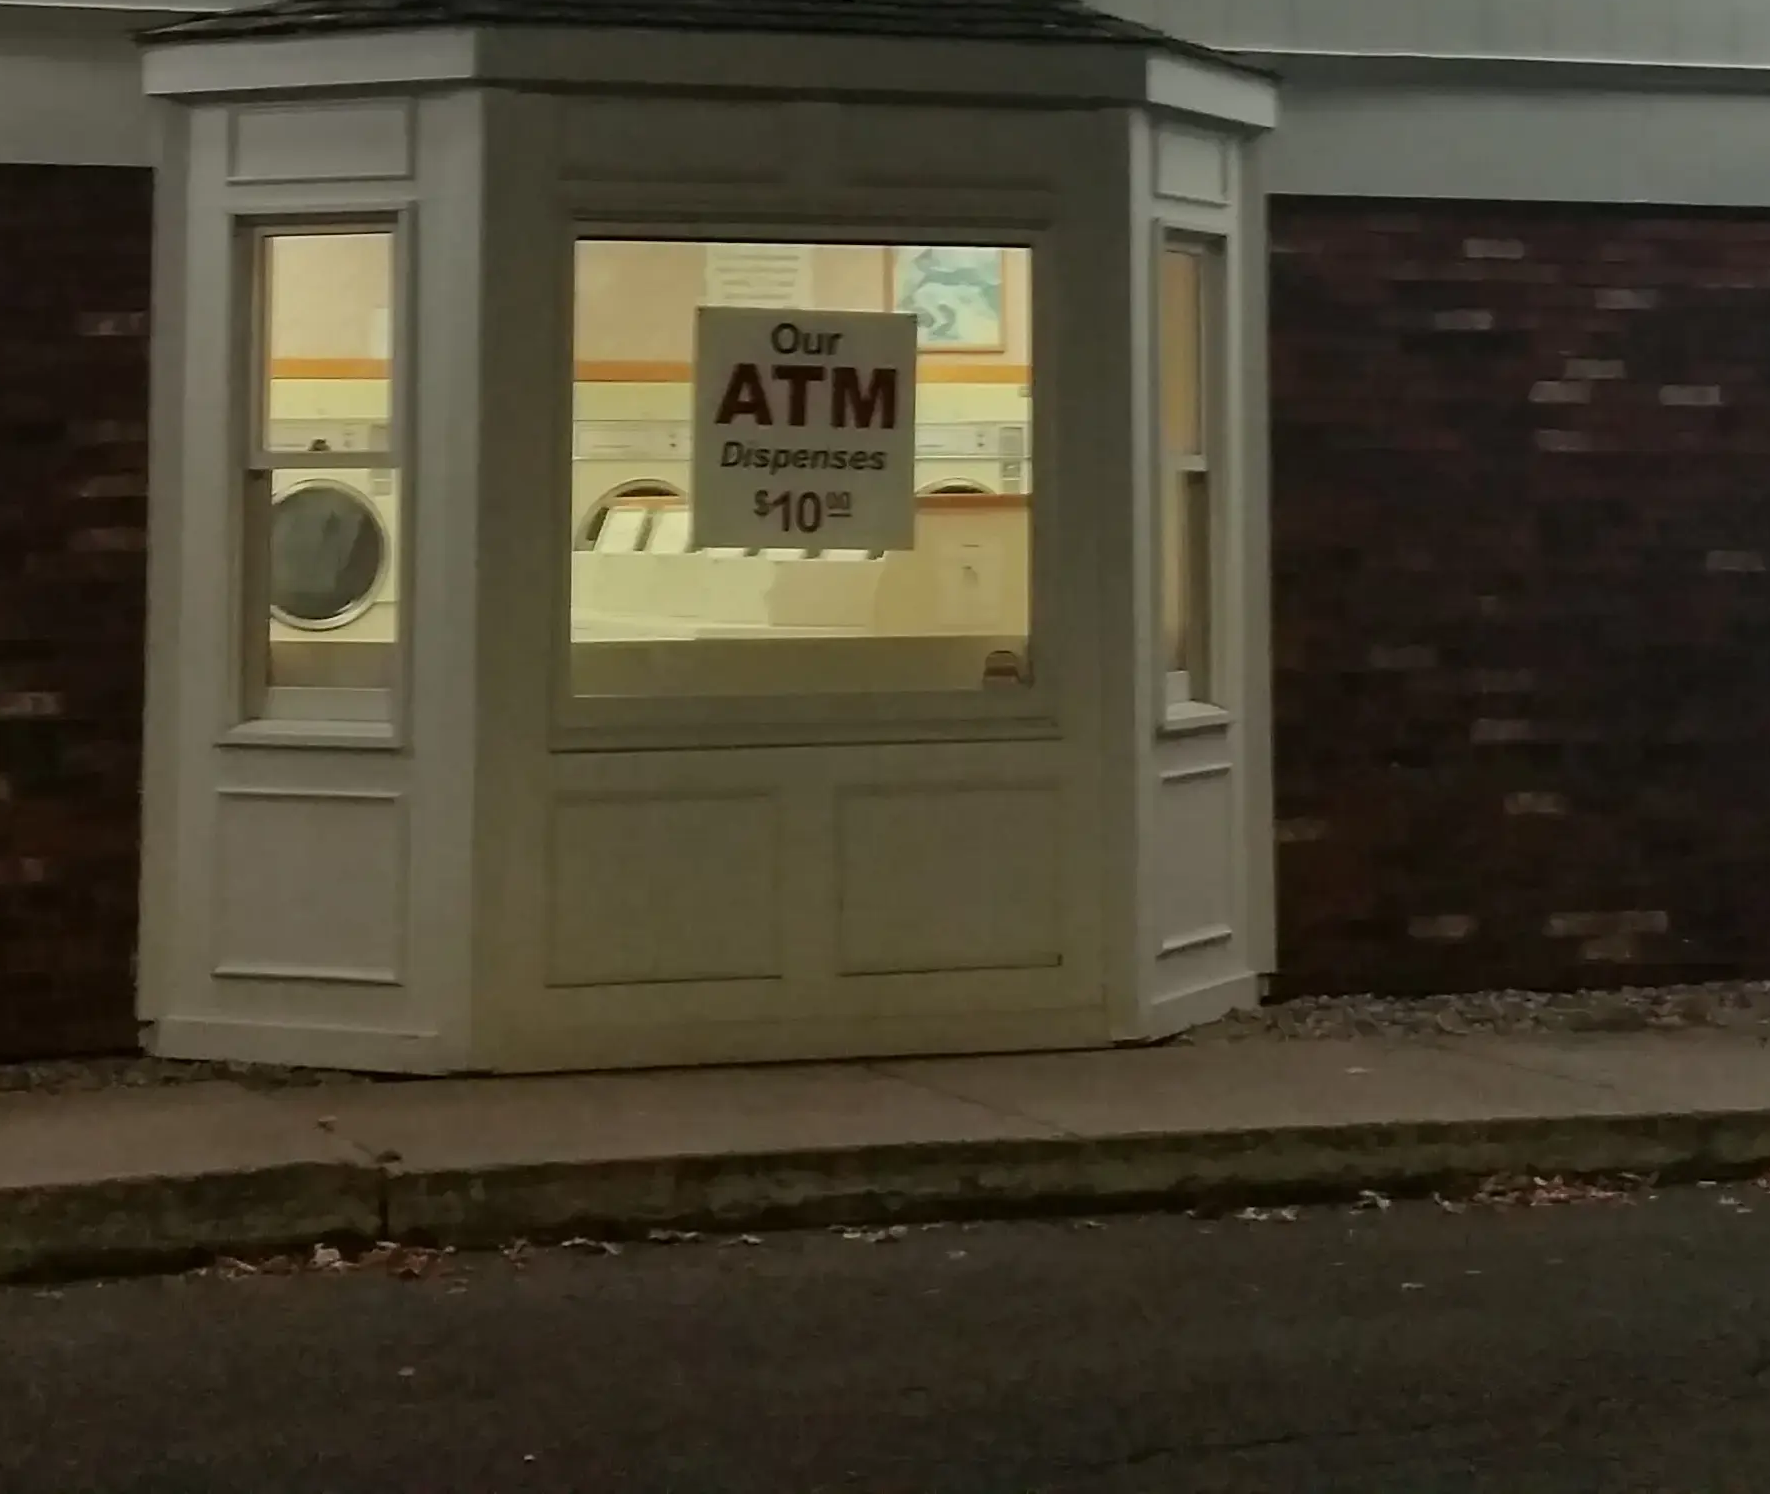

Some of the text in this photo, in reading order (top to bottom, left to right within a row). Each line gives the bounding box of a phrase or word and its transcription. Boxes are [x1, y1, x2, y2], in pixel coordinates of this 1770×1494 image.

[770, 322, 844, 357] Our
[713, 362, 899, 430] ATM
[719, 441, 888, 475] Dispenses
